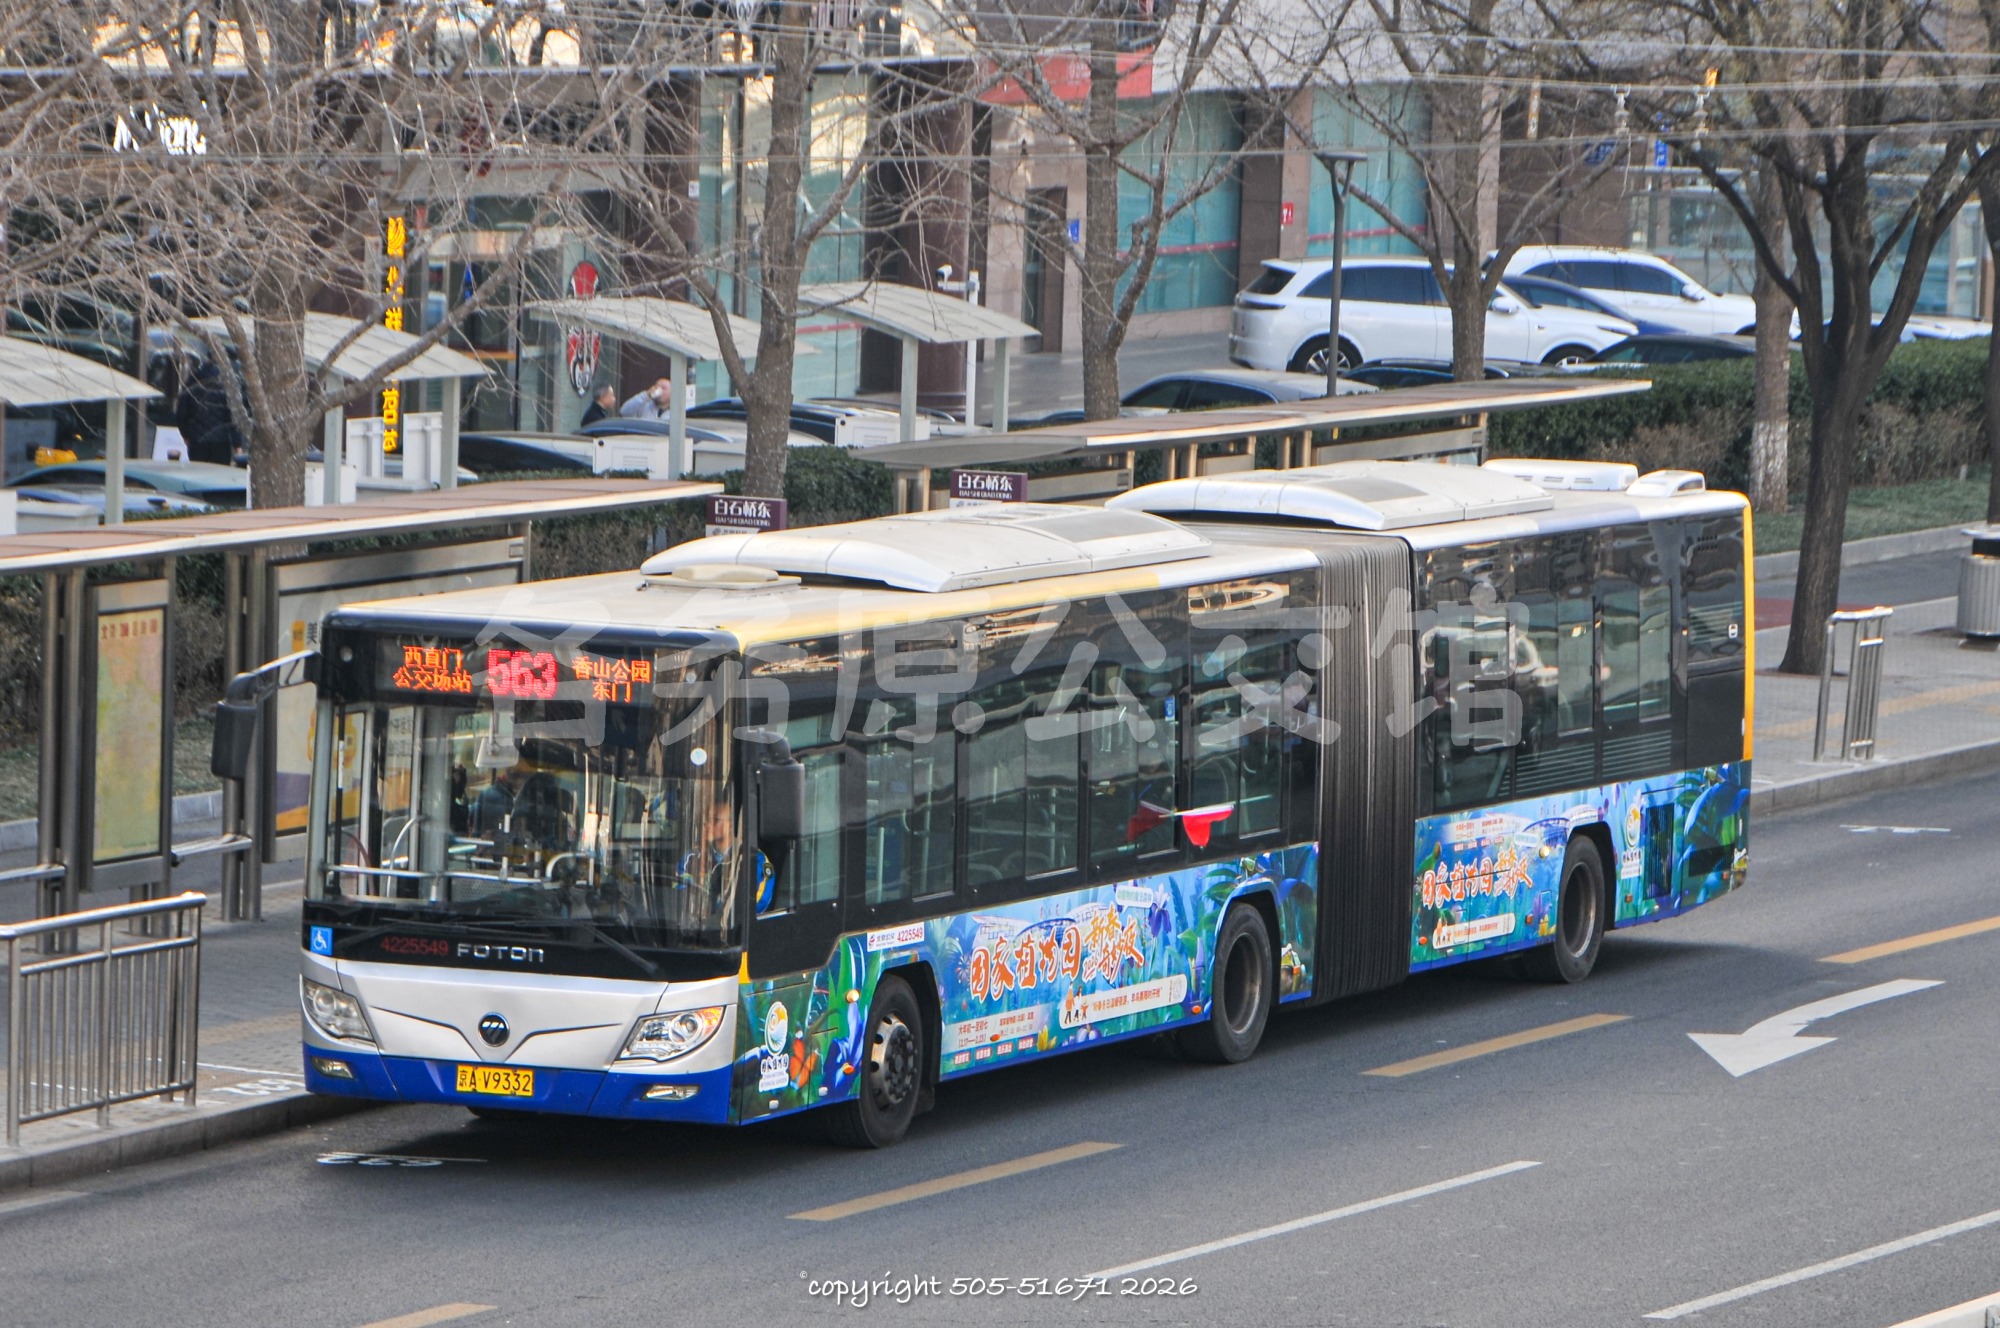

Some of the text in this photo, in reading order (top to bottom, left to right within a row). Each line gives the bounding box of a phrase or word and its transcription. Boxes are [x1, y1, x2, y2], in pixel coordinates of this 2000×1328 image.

[959, 472, 1013, 491] 白石桥东
[714, 499, 771, 518] 白石桥东
[403, 646, 463, 670] 西直门
[572, 656, 651, 683] 香山公园
[393, 666, 473, 694] 公交场站
[487, 649, 558, 698] 563
[593, 678, 632, 704] 东门
[896, 926, 924, 942] 4225549
[380, 936, 449, 957] 4225549
[457, 942, 545, 963] FOTON
[971, 925, 1082, 1003] 国家植物园
